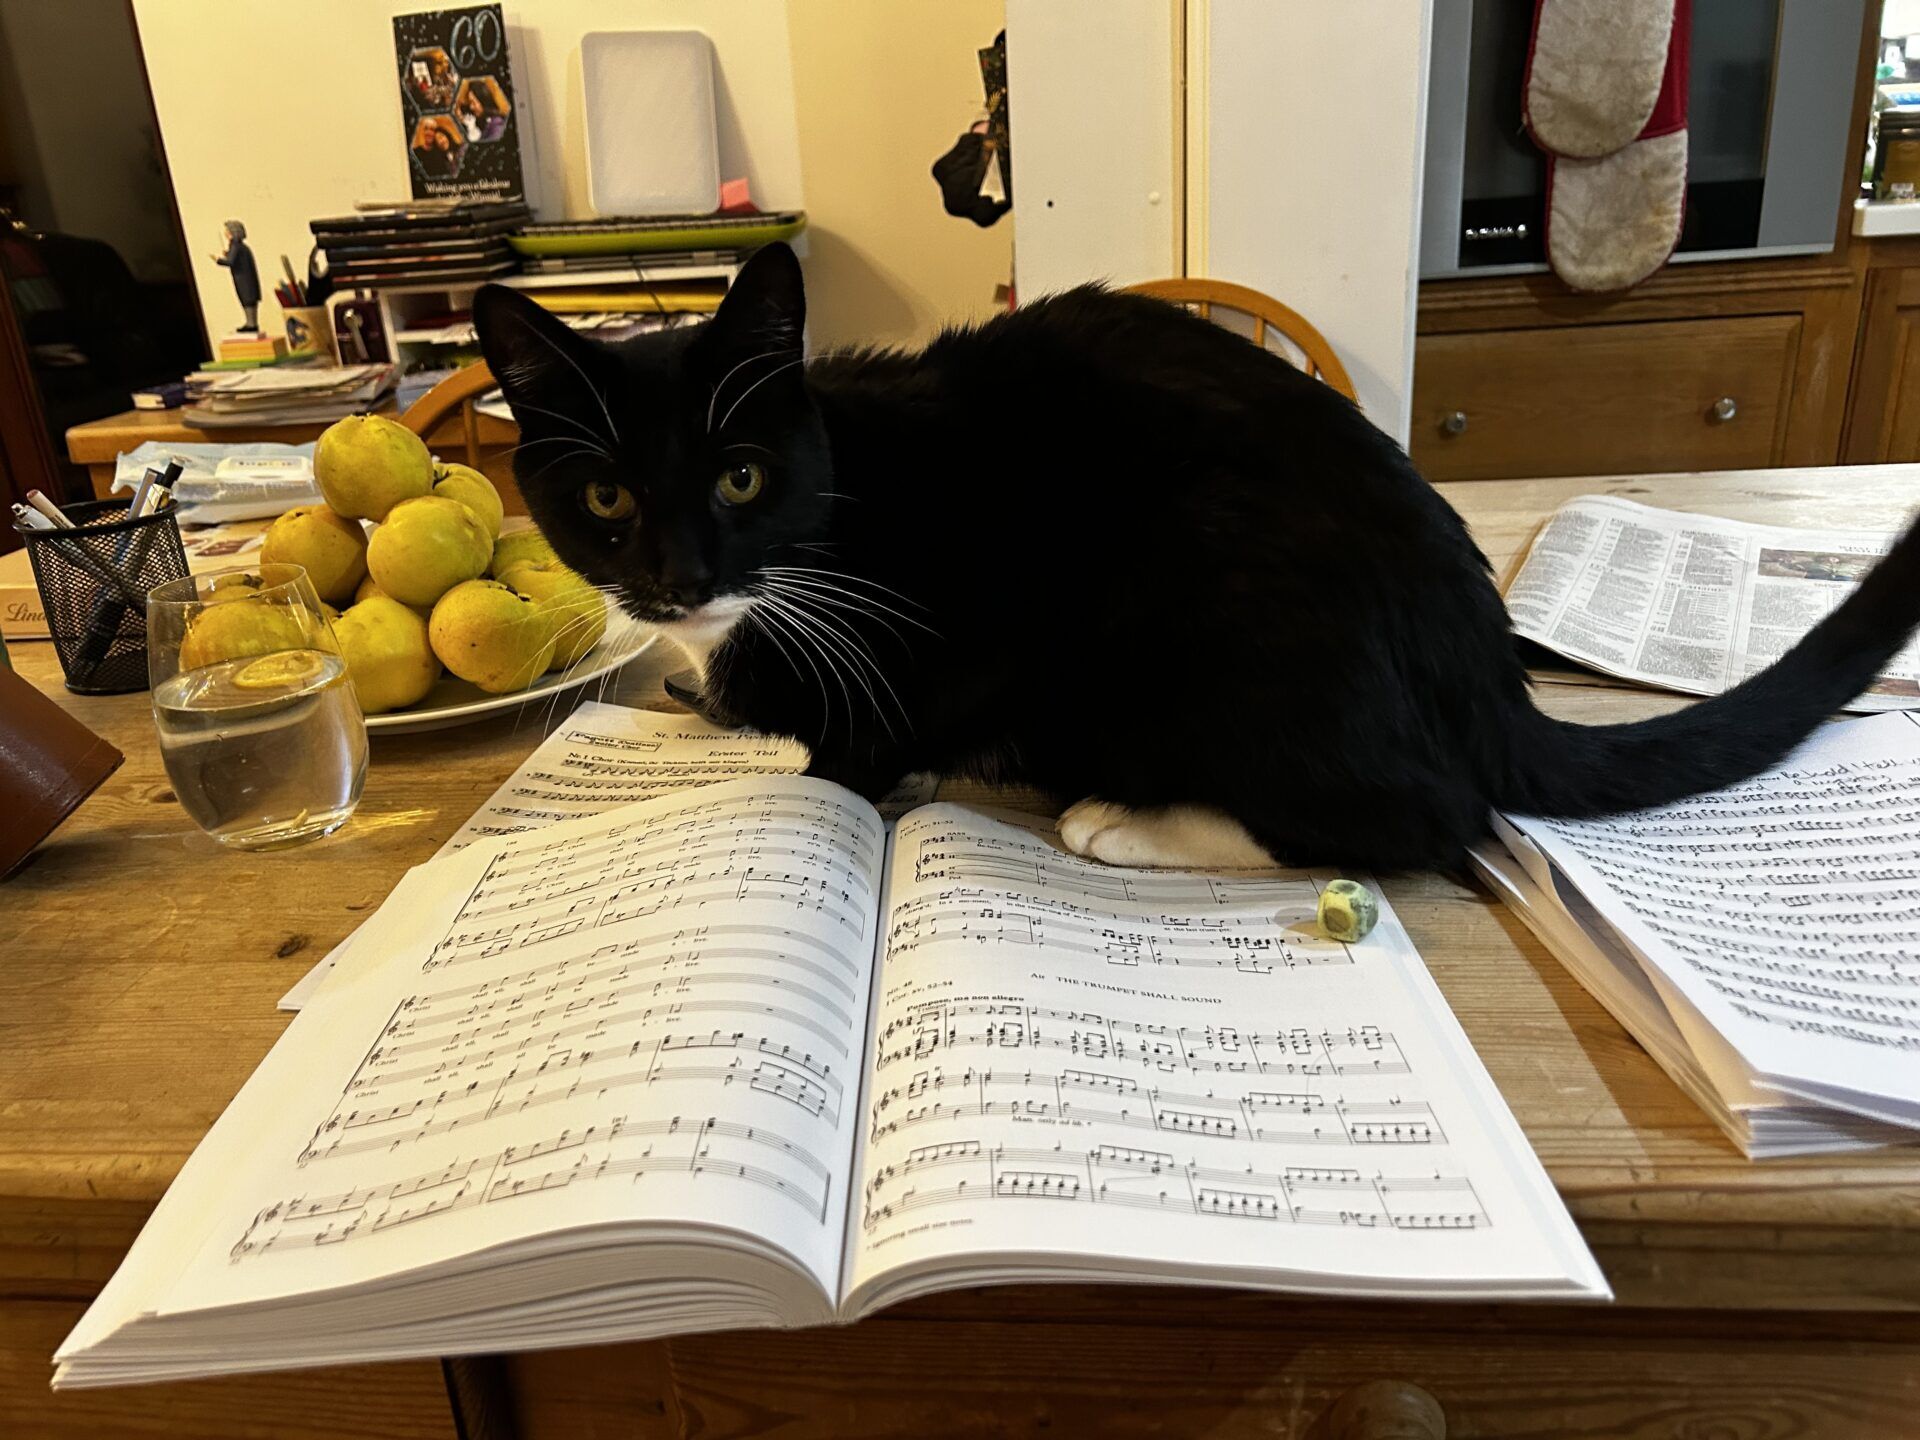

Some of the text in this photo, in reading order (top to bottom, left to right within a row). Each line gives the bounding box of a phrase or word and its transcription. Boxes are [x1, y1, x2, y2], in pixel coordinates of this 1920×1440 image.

[450, 10, 501, 69] 60
[652, 732, 669, 740] St.
[675, 732, 734, 741] Matthew
[592, 755, 614, 763] Chor
[754, 749, 779, 757] Teil
[1056, 975, 1080, 985] THE
[1082, 980, 1138, 995] TRUMPET
[1141, 990, 1179, 1001] SHALL
[1181, 995, 1222, 1004] SOUND
[907, 997, 951, 1012] Pomposo,
[991, 994, 1024, 1002] allegro
